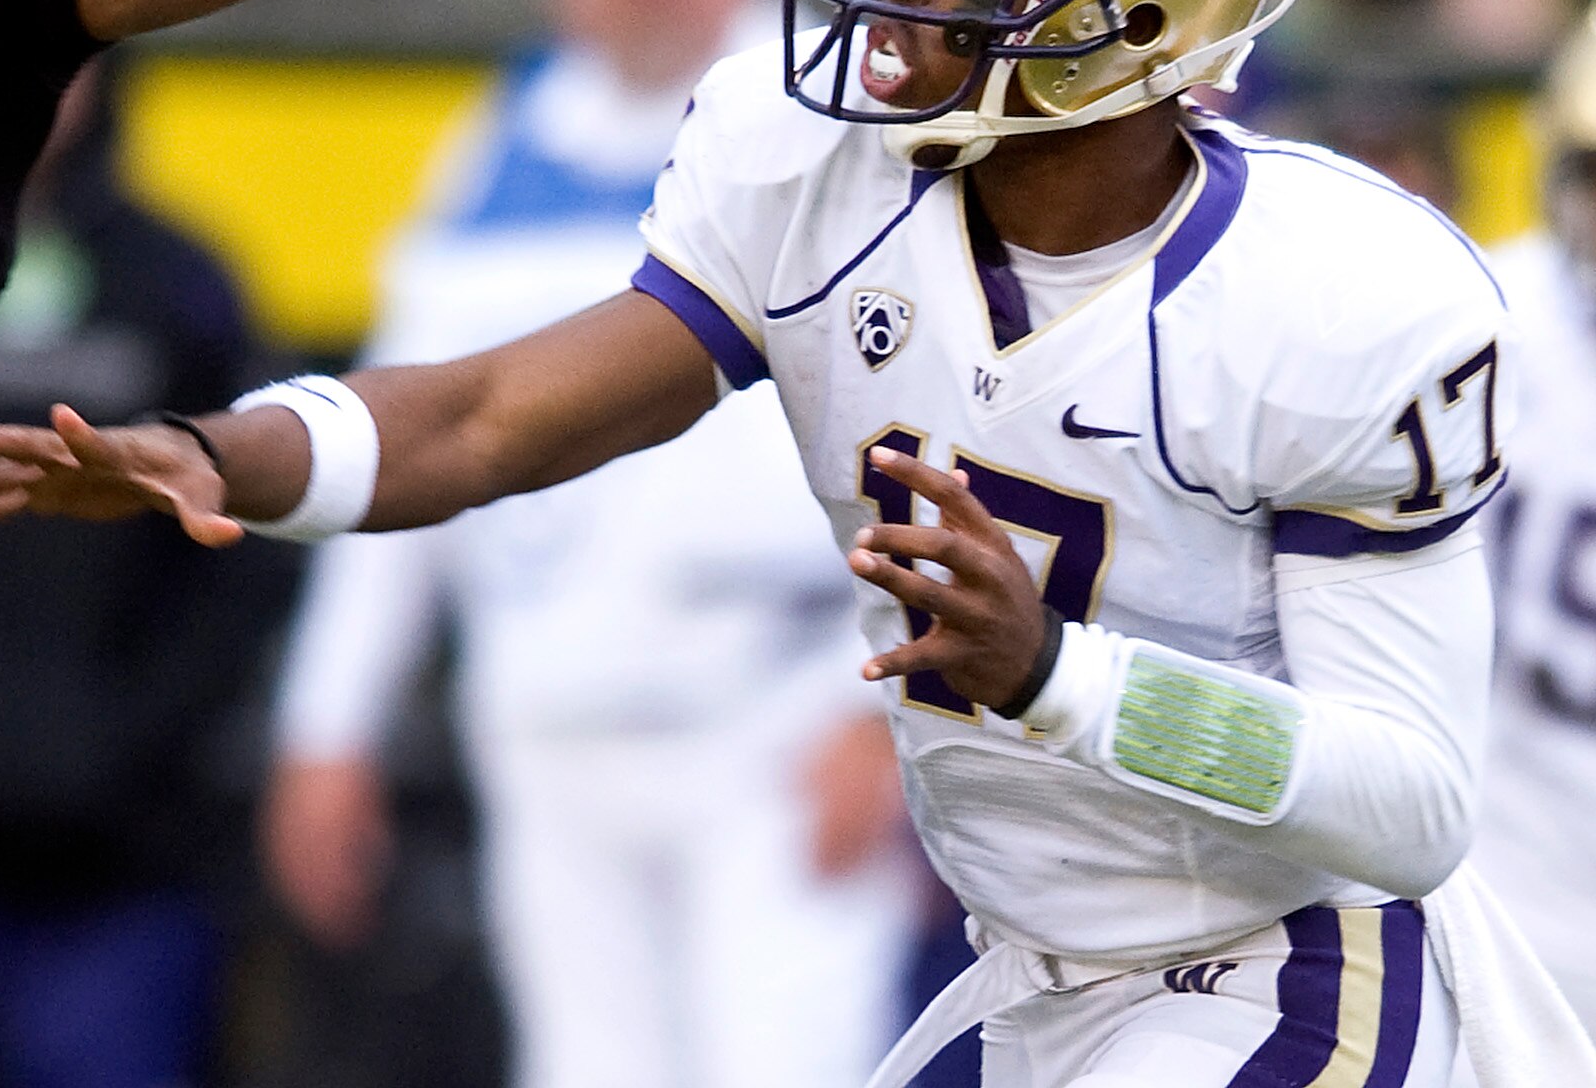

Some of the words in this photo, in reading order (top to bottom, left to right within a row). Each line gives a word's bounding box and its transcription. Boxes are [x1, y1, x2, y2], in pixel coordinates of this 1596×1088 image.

[974, 365, 1002, 402] W
[1390, 336, 1502, 518] 17
[856, 421, 1115, 741] 17
[1163, 961, 1240, 996] W
